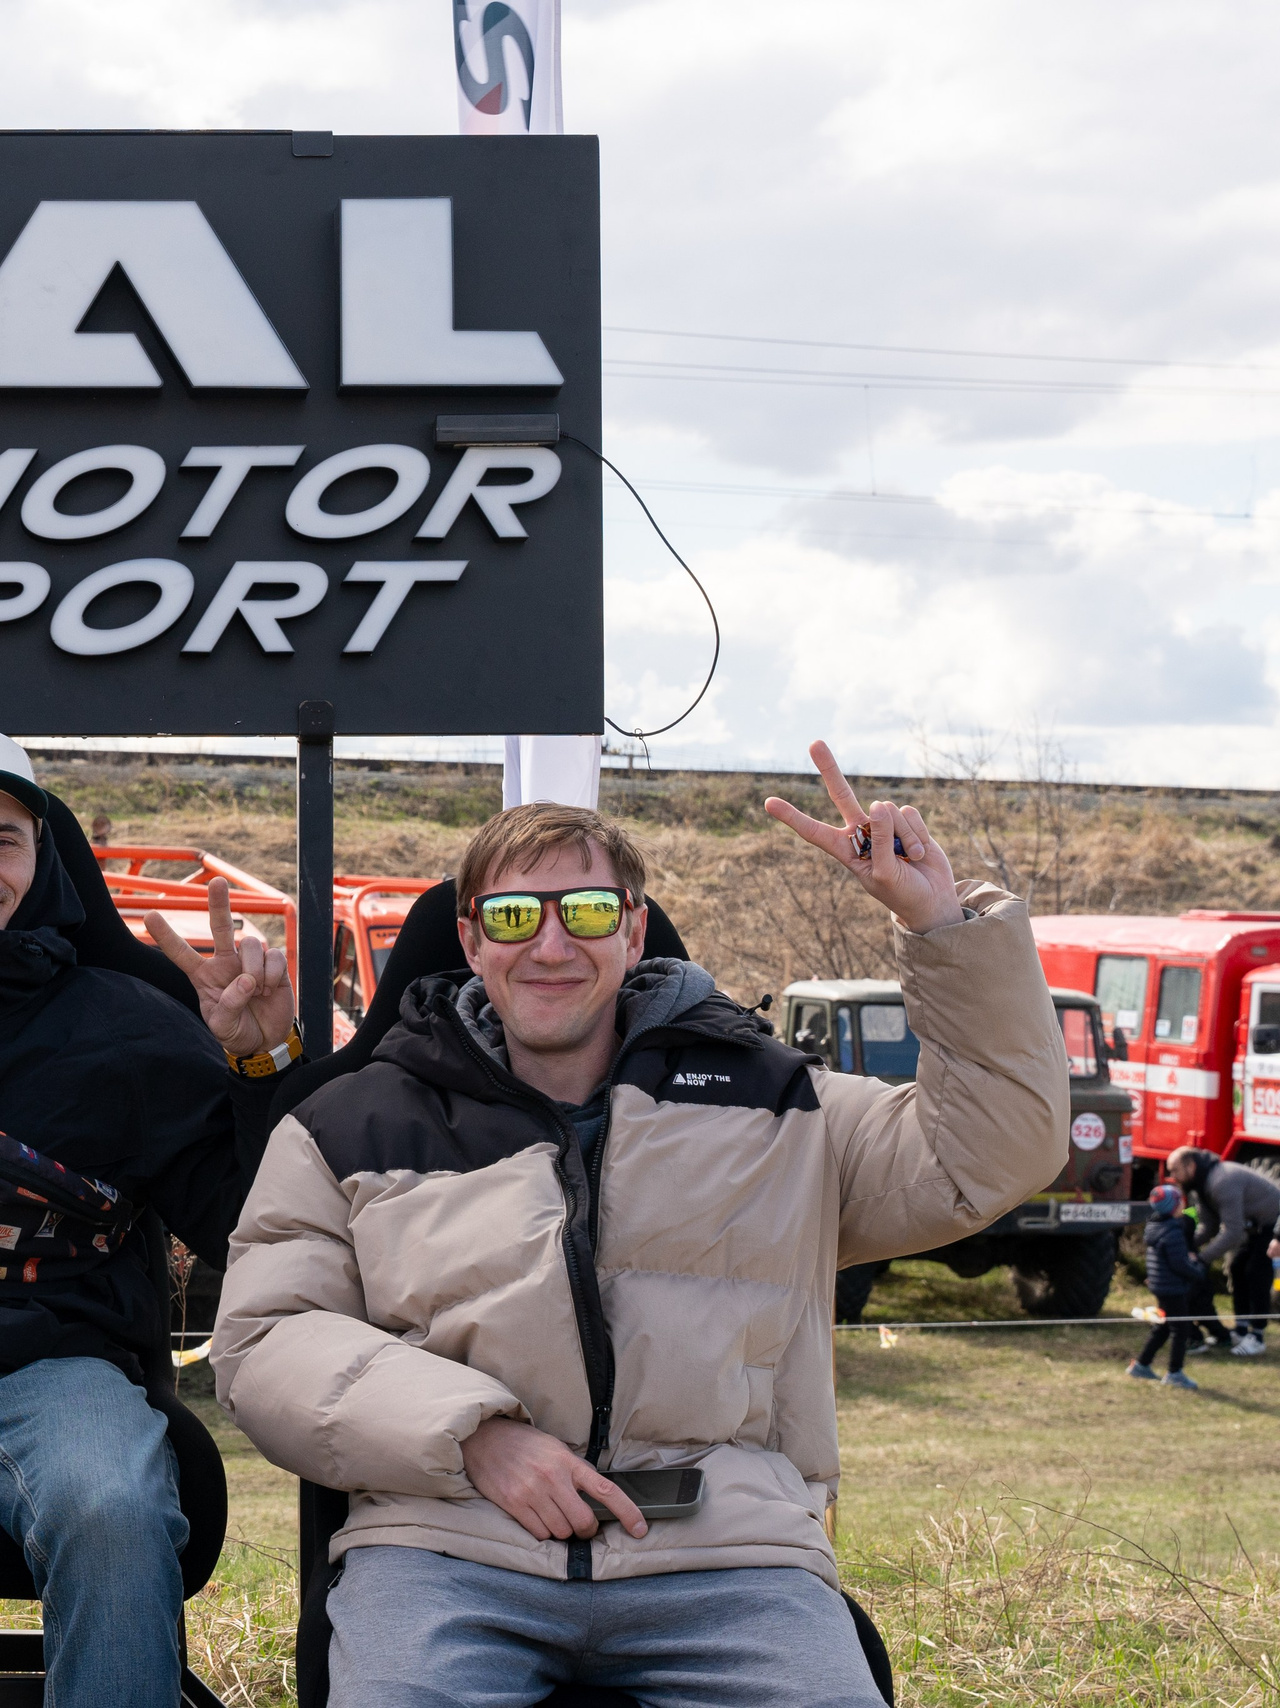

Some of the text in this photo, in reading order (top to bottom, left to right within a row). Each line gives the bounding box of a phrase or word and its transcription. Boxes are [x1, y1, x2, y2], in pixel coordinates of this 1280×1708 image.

[686, 1073, 731, 1082] ENJOY THE
[1073, 1124, 1103, 1138] 526
